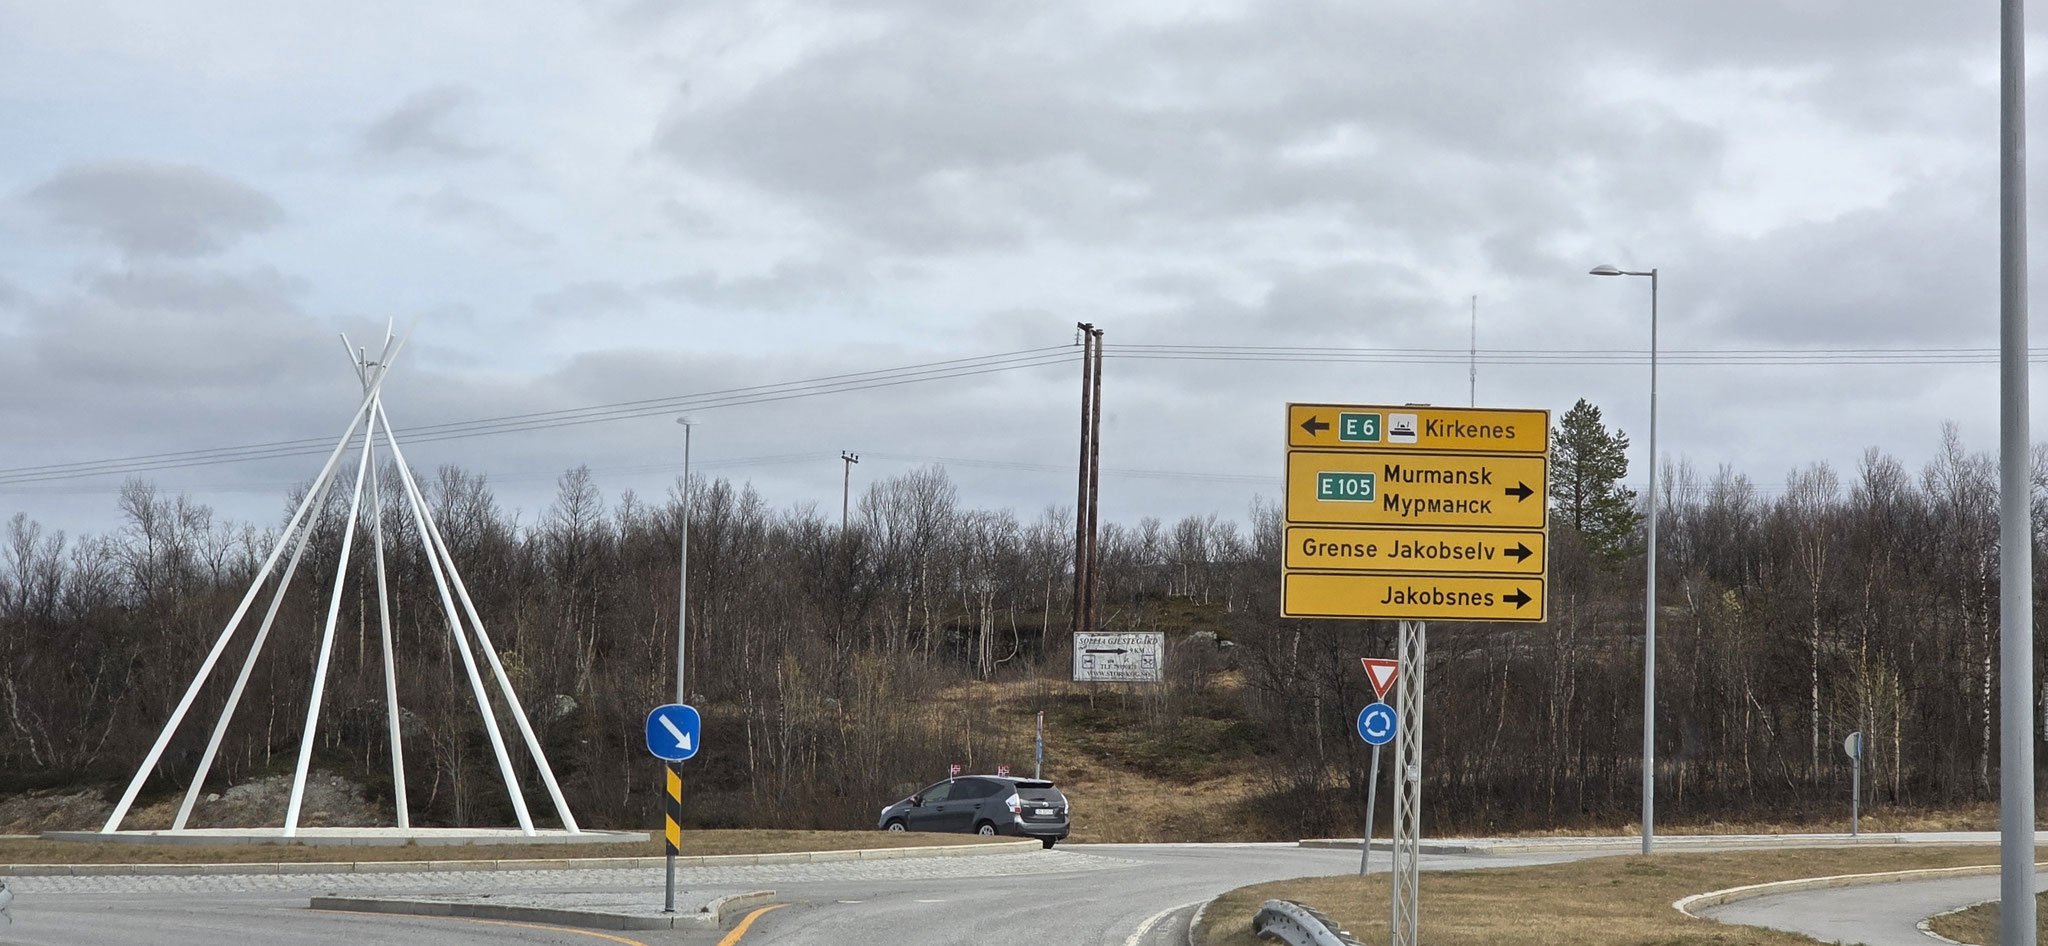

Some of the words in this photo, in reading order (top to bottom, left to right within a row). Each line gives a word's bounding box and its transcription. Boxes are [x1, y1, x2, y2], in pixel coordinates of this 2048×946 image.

[1346, 419, 1357, 435] E
[1363, 419, 1374, 436] 6
[1425, 419, 1516, 439] Kirkenes
[1383, 464, 1492, 485] Murmansk
[1322, 478, 1333, 494] E
[1338, 478, 1371, 496] 105
[1383, 494, 1492, 517] Мурманск
[1302, 538, 1378, 558] Grense
[1387, 540, 1495, 560] Jakobselv
[1380, 586, 1495, 606] Jakobsnes
